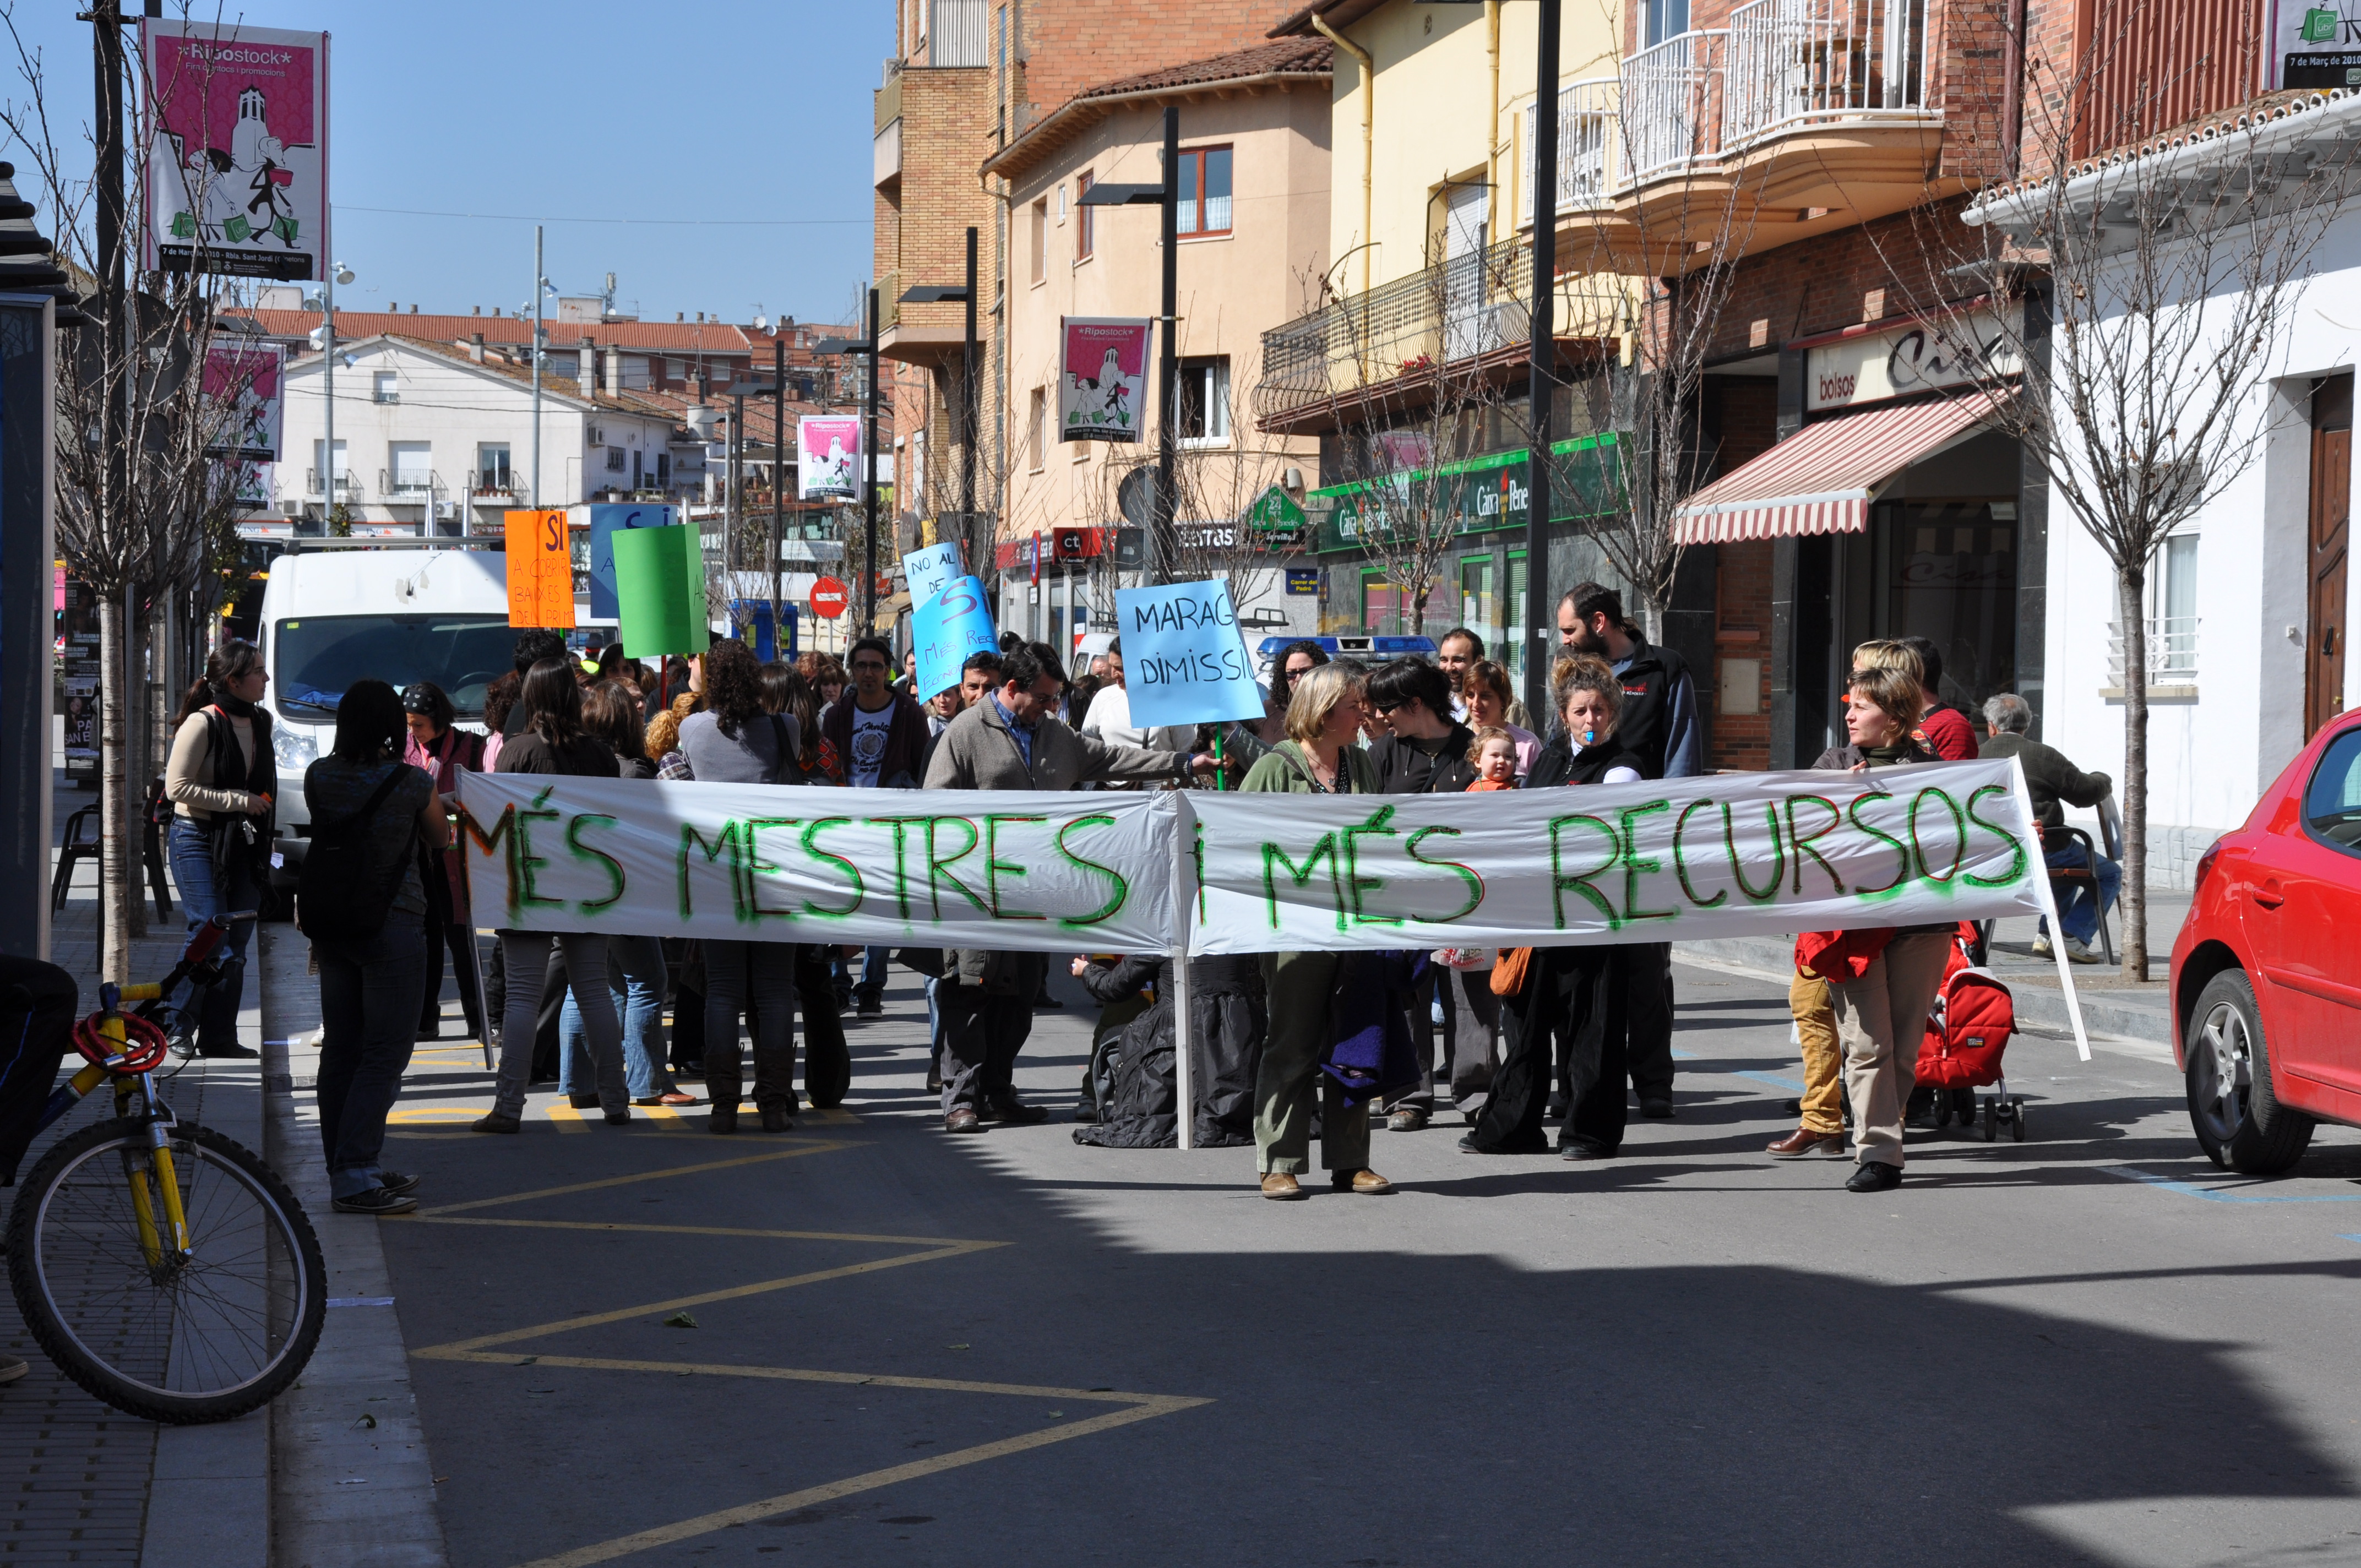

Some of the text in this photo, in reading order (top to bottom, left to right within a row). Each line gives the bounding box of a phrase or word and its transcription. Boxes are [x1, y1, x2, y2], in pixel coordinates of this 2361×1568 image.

[186, 62, 200, 70] Fira
[241, 68, 285, 77] promocions
[2290, 55, 2361, 67] 7 de Març de 2010
[1084, 327, 1128, 337] Ripostock
[1819, 372, 1854, 401] bolsos
[1477, 485, 1499, 516] Caixa
[1339, 509, 1357, 537] Caixa
[1064, 536, 1080, 548] ct
[513, 556, 568, 578] A COBRIR
[911, 553, 955, 575] NO AL
[514, 584, 561, 603] BAIXES
[516, 610, 539, 626] DEL
[1135, 593, 1234, 633] MARAG
[925, 641, 957, 665] MÉS
[456, 785, 626, 923] MÉS
[678, 815, 1129, 926] MESTRES
[1263, 804, 1486, 930] MÉS
[1549, 785, 2028, 931] RECURSOS
